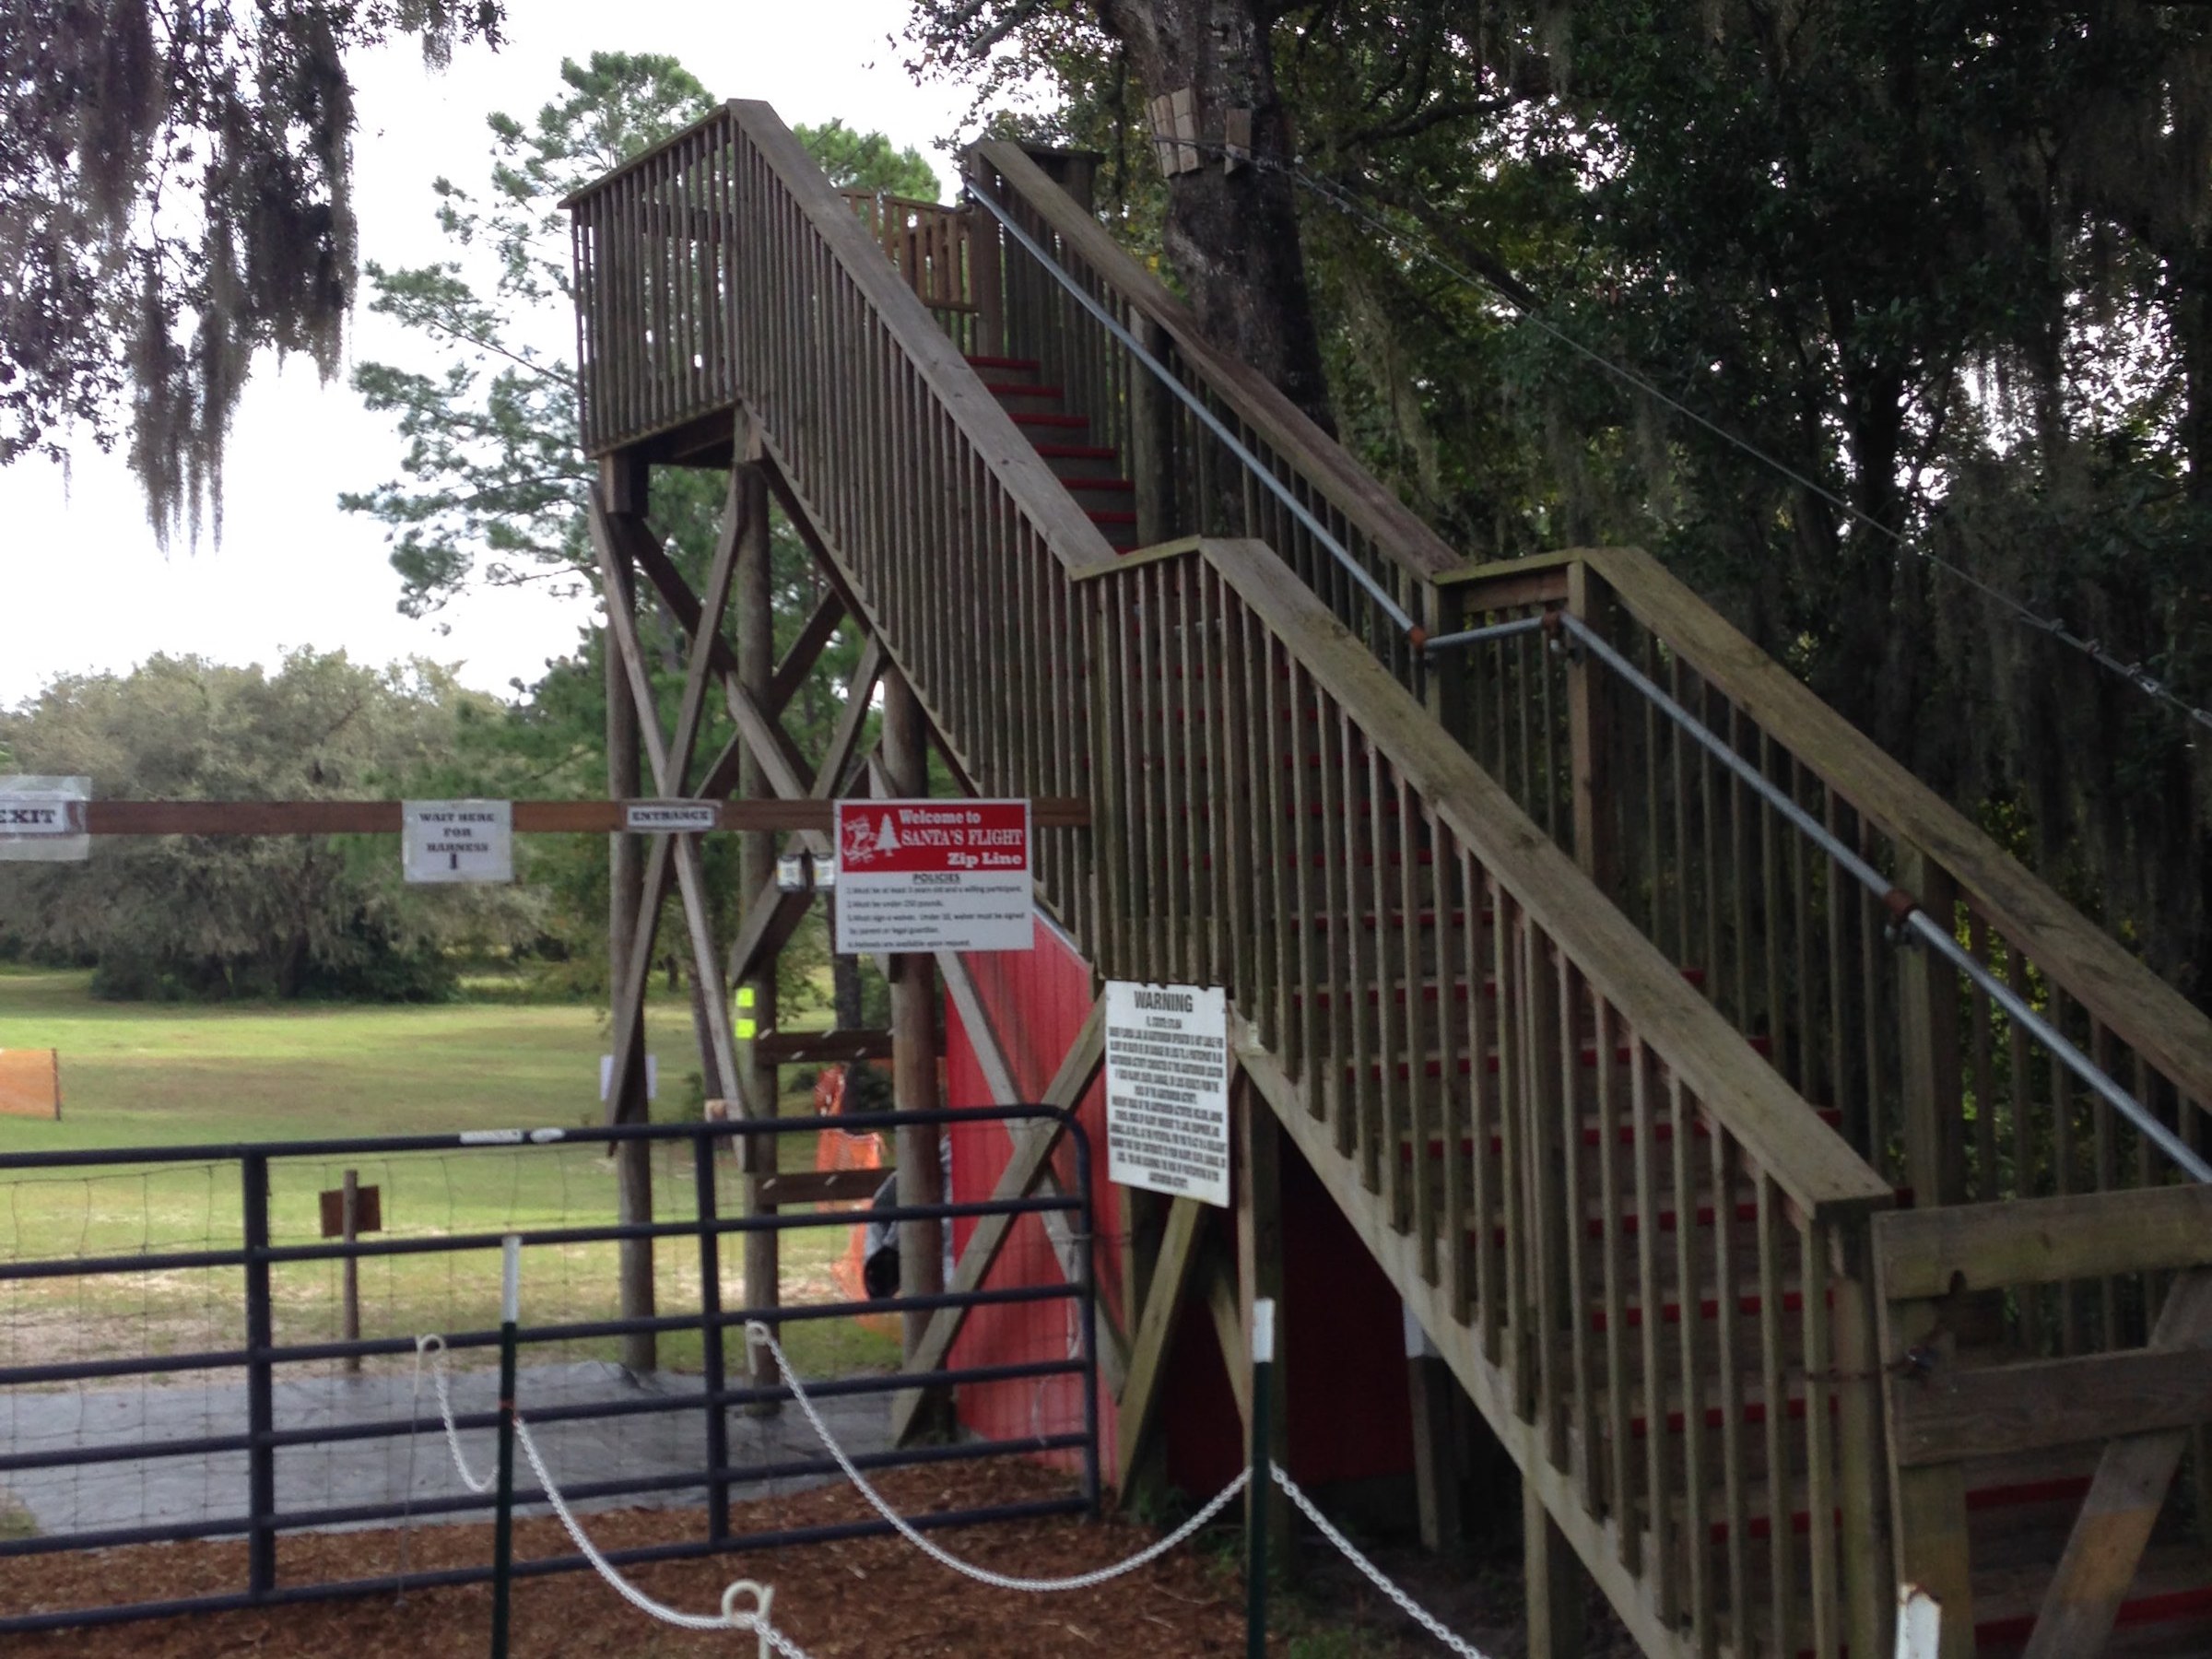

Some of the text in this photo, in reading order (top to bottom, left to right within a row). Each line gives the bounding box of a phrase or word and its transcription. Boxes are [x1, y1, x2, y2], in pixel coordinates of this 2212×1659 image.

[419, 813, 495, 821] WAIT HERE
[632, 810, 708, 820] ENTRANCE
[899, 809, 981, 824] Welcome to
[443, 828, 471, 837] FOR
[901, 829, 1022, 846] SANTA'S FLIGHT
[426, 843, 488, 852] HARNESS
[947, 853, 1022, 868] Zip Line
[912, 874, 960, 883] POLICIES
[1134, 991, 1193, 1012] WARNING
